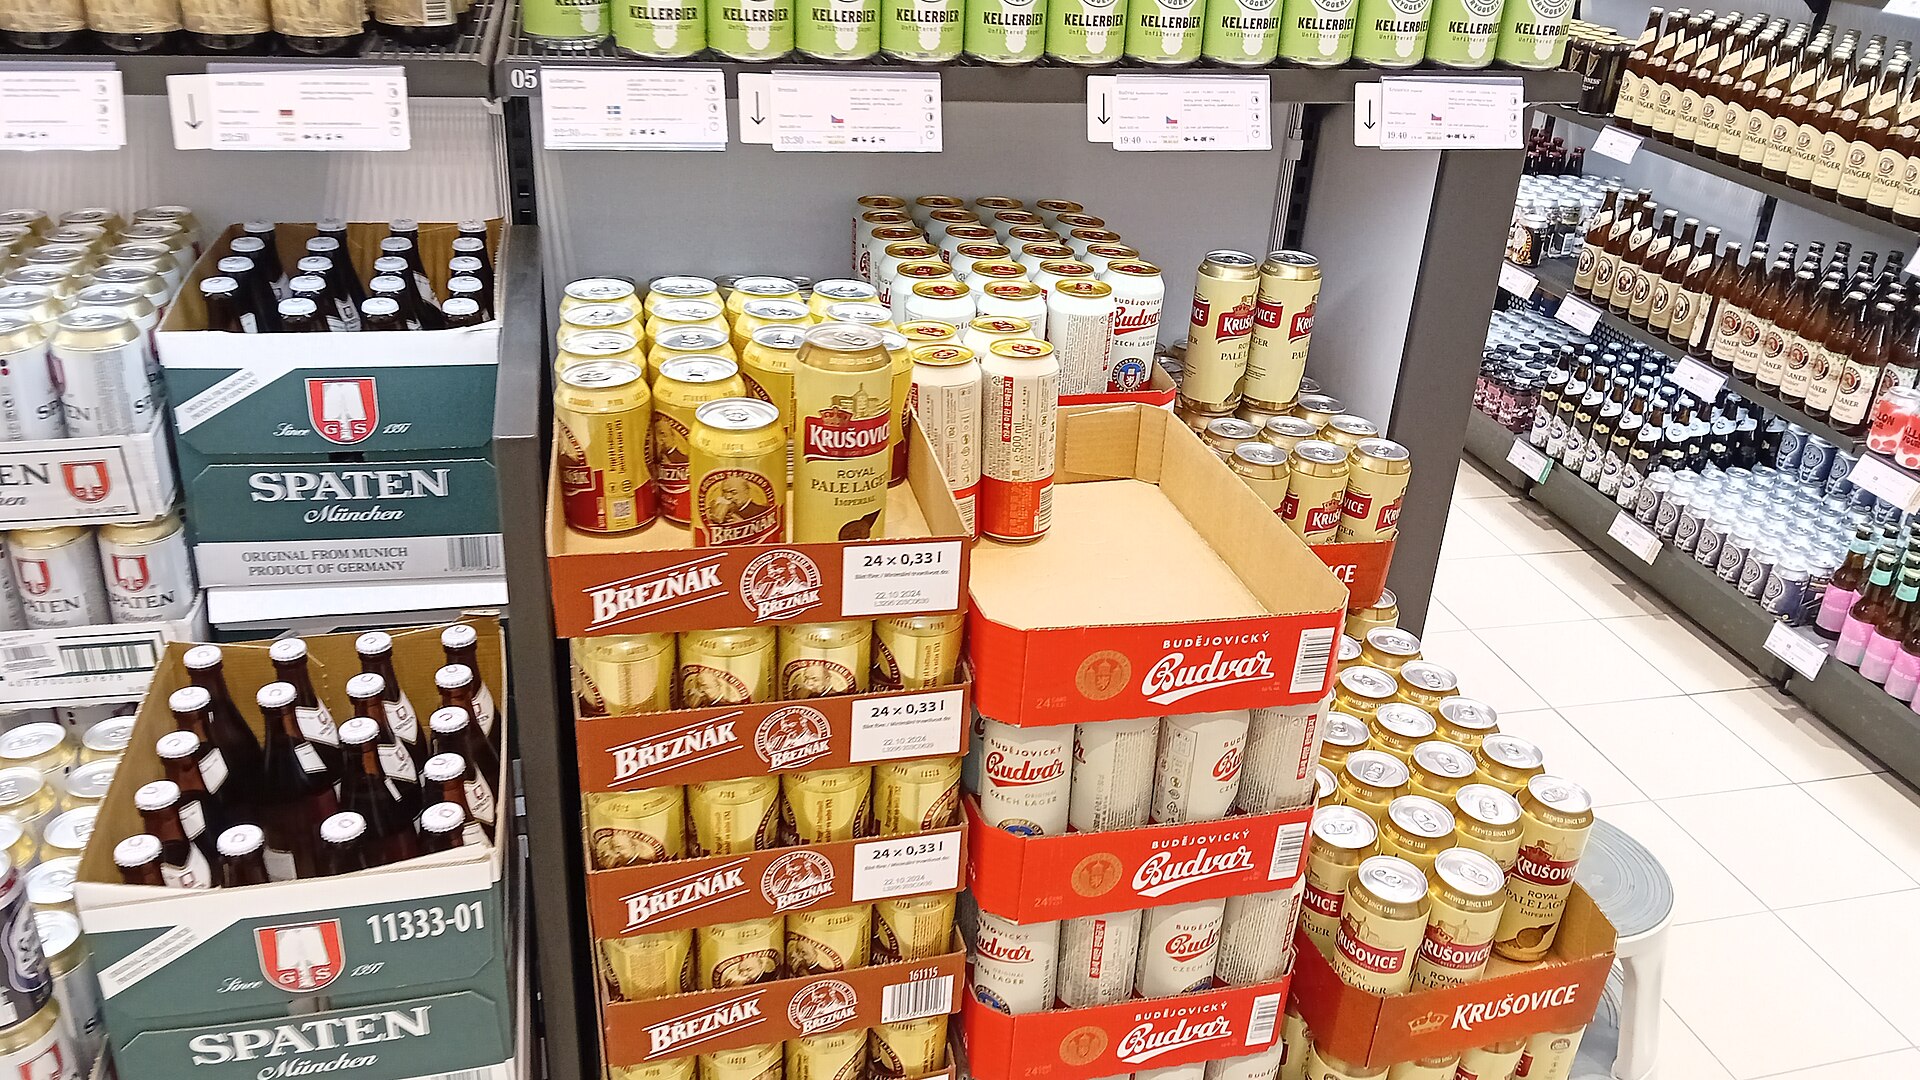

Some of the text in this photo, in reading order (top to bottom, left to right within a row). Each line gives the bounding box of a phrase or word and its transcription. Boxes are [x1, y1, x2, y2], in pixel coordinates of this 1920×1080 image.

[629, 6, 698, 20] KELLERBIER
[723, 7, 788, 22] KELLERBIER
[812, 8, 875, 23] KELLERBIER
[897, 9, 959, 23] KELLERBIER
[984, 12, 1043, 26] KELLERBIER
[1064, 13, 1124, 26] KELLERBIER
[1141, 15, 1200, 28] KELLERBIER
[1222, 16, 1279, 30] KELLERBIER
[1298, 17, 1354, 30] KELLERBIER
[511, 69, 537, 88] 05
[1012, 435, 1021, 453] 500
[837, 467, 876, 479] ROYAL
[249, 469, 450, 502] SPATEN
[811, 478, 850, 494] PALE
[304, 504, 405, 524] München
[242, 547, 409, 563] ORIGINAL FROM MUNICH
[864, 555, 883, 567] 24
[900, 552, 933, 567] 0,33
[248, 560, 406, 577] PRODUCT OF GERMANY
[591, 562, 722, 624] BŘEZŇÁK
[1162, 631, 1271, 650] BUDĚJOVICKÝ
[1141, 650, 1275, 705] Budvar
[870, 706, 889, 719] 24
[906, 701, 936, 714] 0,33
[613, 720, 737, 781] BŘEZŇÁK
[985, 751, 1065, 787] Budvar
[990, 788, 1057, 807] CZECH LAGER
[1151, 829, 1250, 851] BUDĚJOVICKÝ
[872, 848, 890, 860] 24
[905, 843, 935, 856] 0,33
[1131, 845, 1255, 897] Budvar
[626, 867, 745, 928] BŘEZŇÁK
[1505, 890, 1535, 908] PALE
[1527, 890, 1559, 900] ROYAL
[367, 901, 486, 946] 11333-01
[977, 935, 1034, 964] udvar
[1340, 929, 1398, 970] RUŠOVICE
[909, 966, 939, 982] 161115
[1341, 961, 1367, 981] ROYAL
[1416, 972, 1438, 989] ALE
[1429, 971, 1465, 984] ROYAL
[1349, 976, 1387, 995] LAGER
[1135, 1001, 1229, 1023] BUDĚJOVICKÝ
[1451, 983, 1579, 1032] KRUŠOVICE
[188, 1005, 432, 1066] SPATEN
[647, 997, 762, 1056] BŘEZŇÁK
[1116, 1016, 1233, 1065] Budvar
[257, 1053, 380, 1080] München
